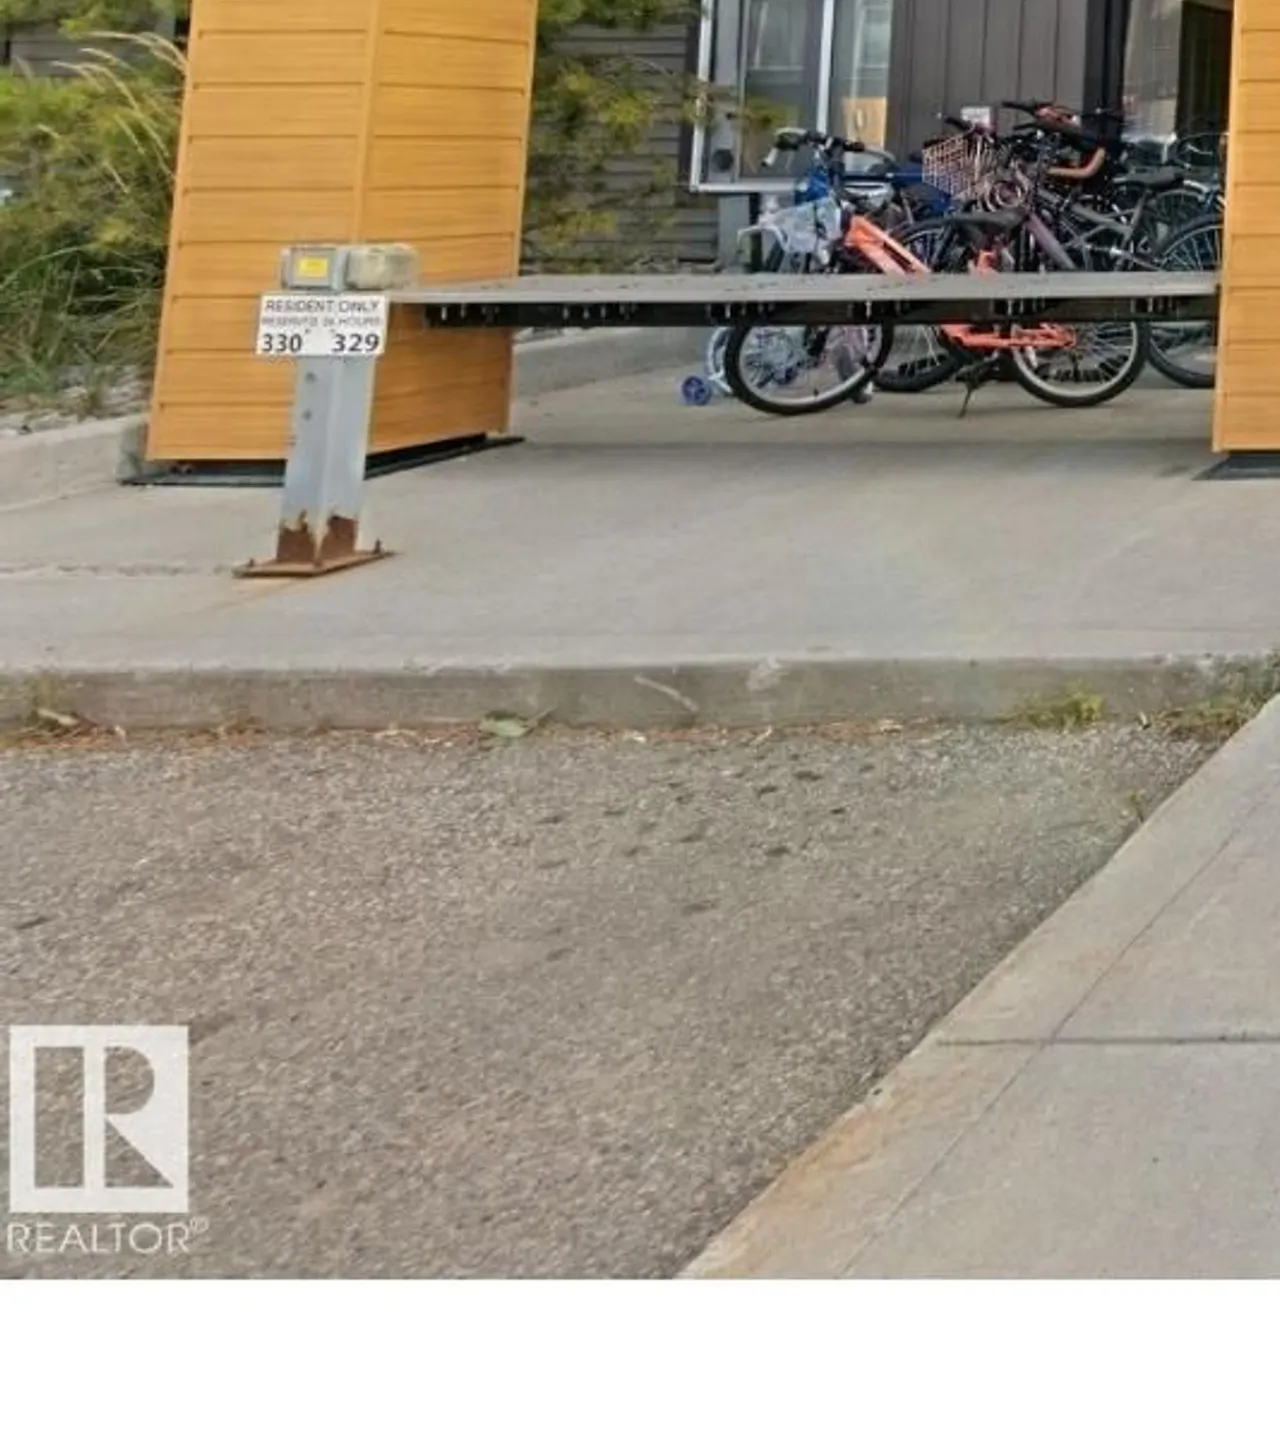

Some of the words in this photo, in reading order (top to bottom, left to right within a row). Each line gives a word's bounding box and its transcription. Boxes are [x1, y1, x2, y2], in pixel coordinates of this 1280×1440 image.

[265, 300, 334, 312] RESIDENT
[338, 300, 379, 312] ONLY
[262, 333, 302, 353] 330
[332, 333, 380, 353] 329
